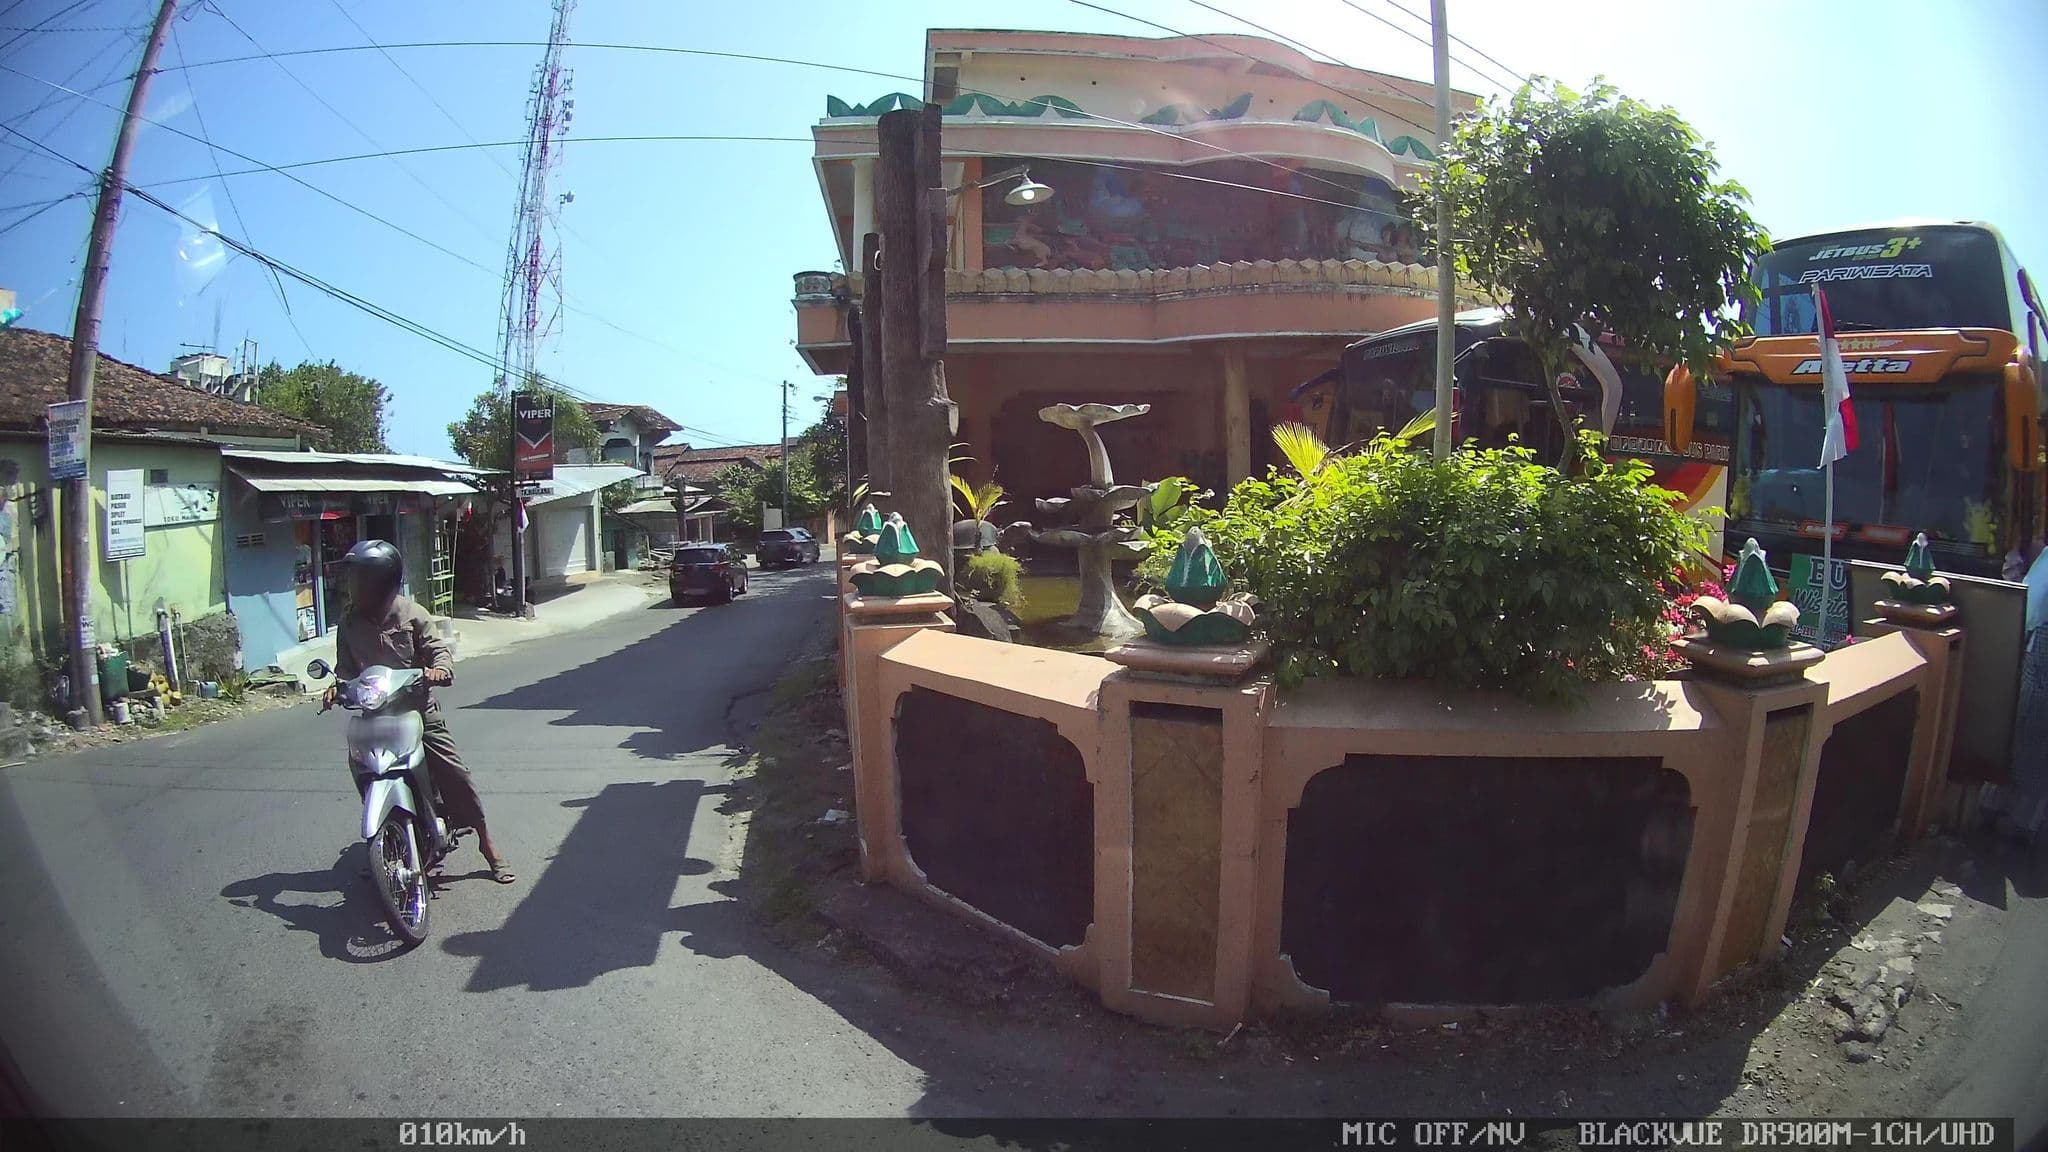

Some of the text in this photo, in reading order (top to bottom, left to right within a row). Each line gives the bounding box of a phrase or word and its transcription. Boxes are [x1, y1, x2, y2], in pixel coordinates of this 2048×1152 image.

[1799, 264, 1933, 284] PARIWISATA
[519, 408, 552, 419] VIPER
[280, 494, 311, 508] VIPER
